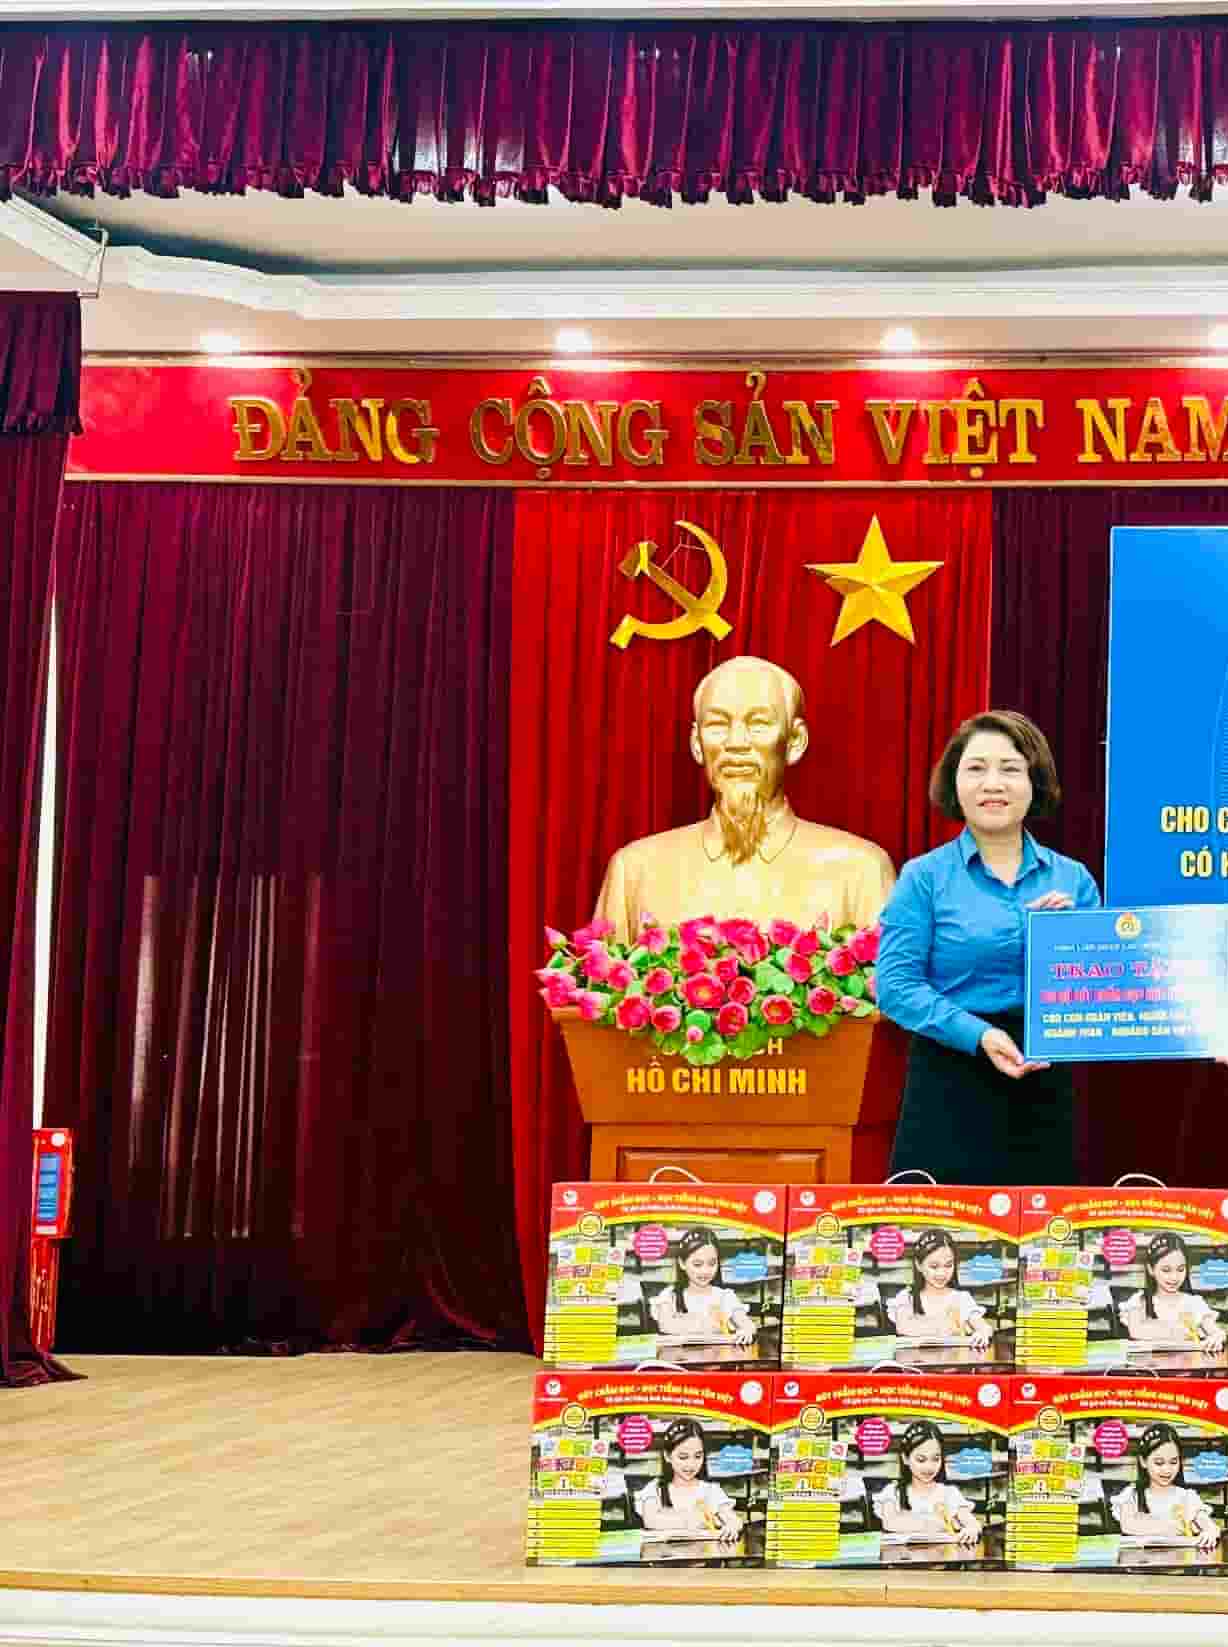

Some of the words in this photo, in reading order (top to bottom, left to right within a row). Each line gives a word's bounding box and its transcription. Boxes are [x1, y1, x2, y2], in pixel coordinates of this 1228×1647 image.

[231, 368, 440, 463] ĐẢNG
[470, 376, 667, 478] CỘNG
[694, 370, 838, 465] SẢN
[866, 377, 1044, 478] VIỆT
[1160, 806, 1210, 833] CHO
[1180, 846, 1212, 877] CÓ
[671, 1068, 721, 1094] CHI
[729, 1068, 807, 1094] MINH
